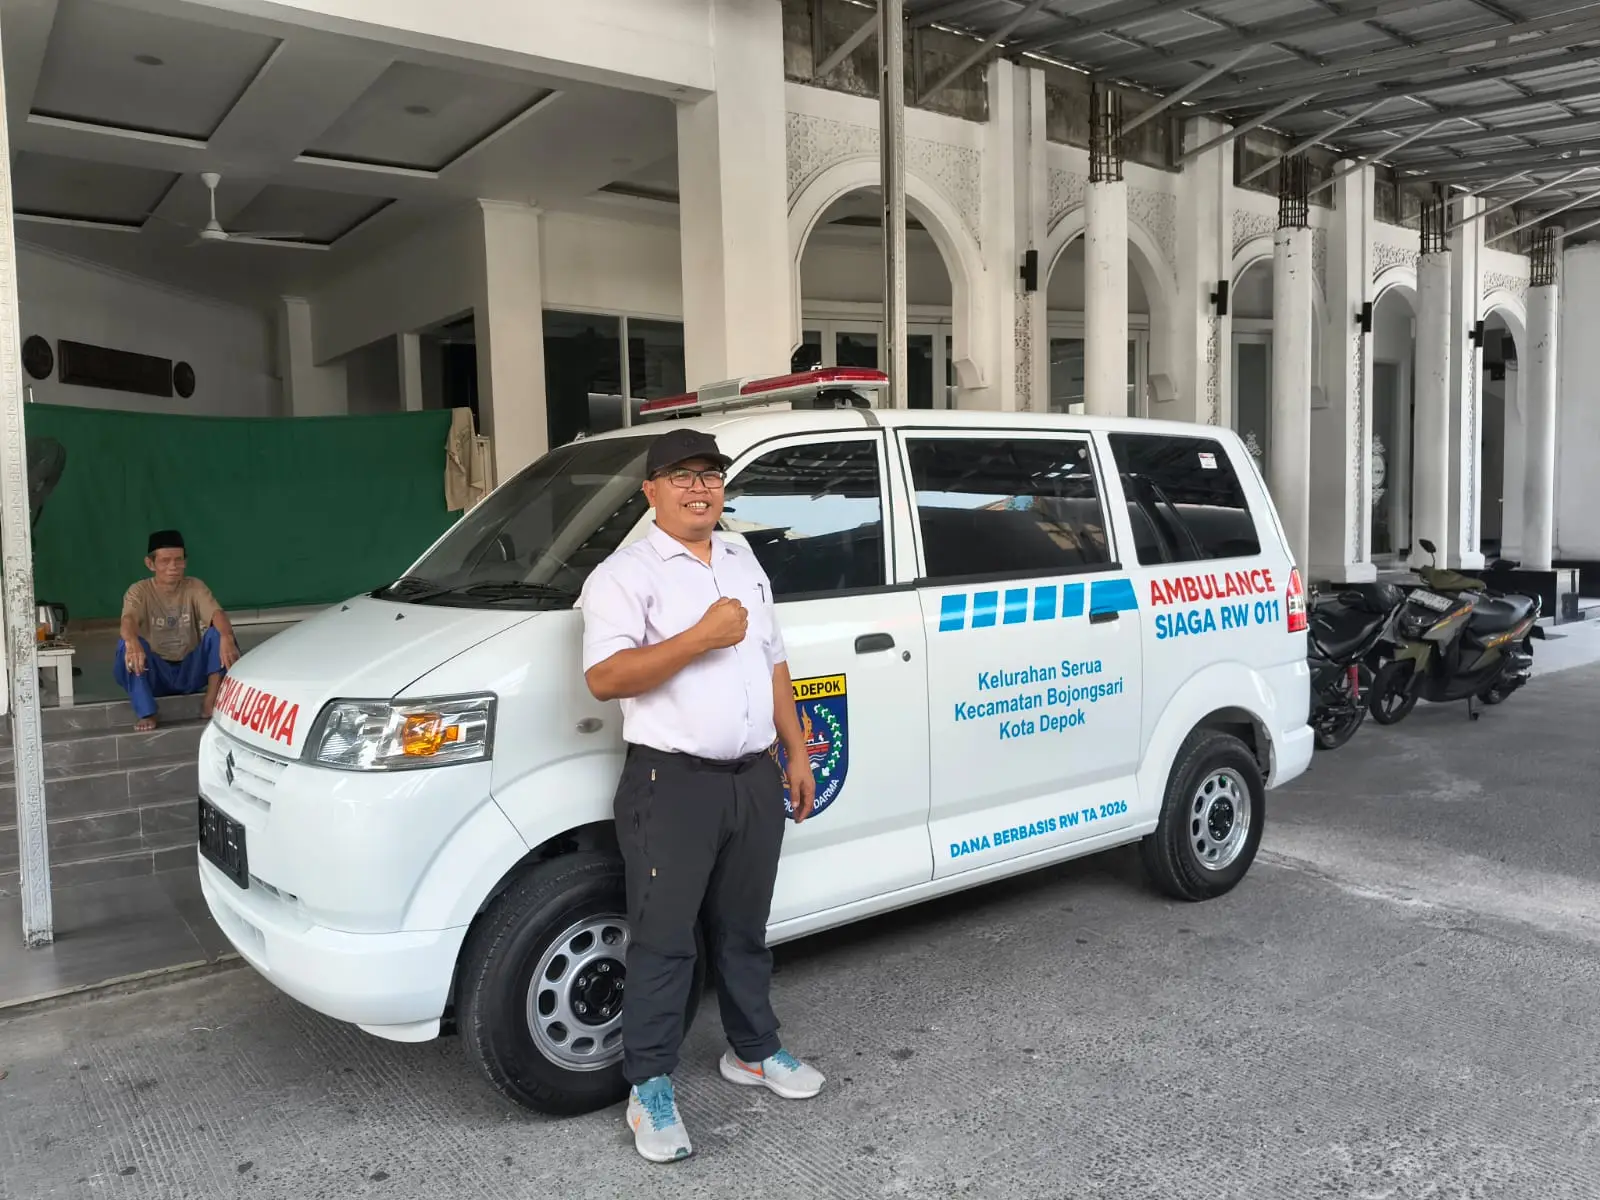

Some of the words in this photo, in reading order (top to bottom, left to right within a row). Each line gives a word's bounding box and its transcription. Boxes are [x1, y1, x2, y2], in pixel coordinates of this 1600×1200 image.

[1150, 568, 1276, 607] AMBULANCE
[1155, 608, 1216, 640] SIAGA
[1220, 602, 1251, 630] RW
[1253, 599, 1281, 626] 011
[800, 680, 841, 697] DEPOK
[978, 666, 1057, 691] Kelurahan
[1060, 659, 1102, 679] Serua
[953, 693, 1044, 722] Kecamatan
[1047, 676, 1125, 709] Bojongsari
[998, 719, 1036, 741] Kota
[1039, 709, 1086, 734] Depok
[813, 779, 839, 809] DARMA
[950, 836, 991, 858] DANA
[993, 818, 1057, 847] BERBASIS
[1058, 811, 1080, 829] RW
[1081, 808, 1098, 823] TA
[1099, 801, 1128, 818] 2026
